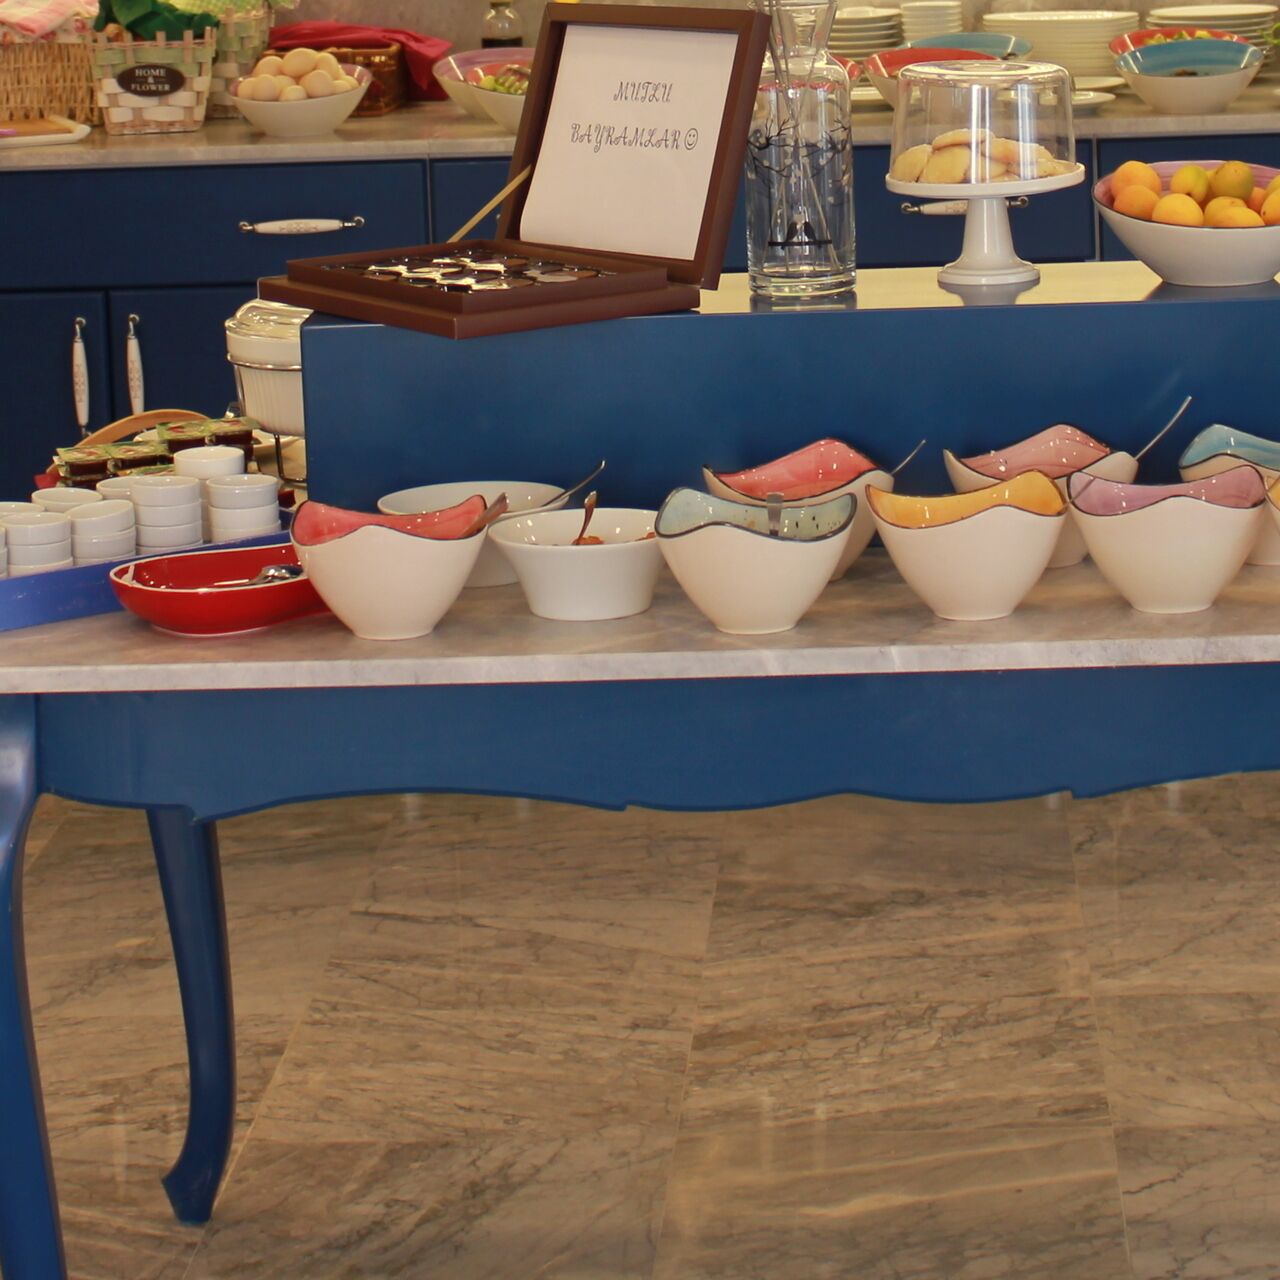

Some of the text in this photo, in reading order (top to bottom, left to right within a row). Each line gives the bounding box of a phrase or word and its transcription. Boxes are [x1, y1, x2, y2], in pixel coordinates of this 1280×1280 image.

[135, 68, 167, 77] HOME
[131, 83, 171, 92] FLOWER
[613, 80, 674, 103] MUTLU
[570, 122, 682, 154] BAYRAMLAR
